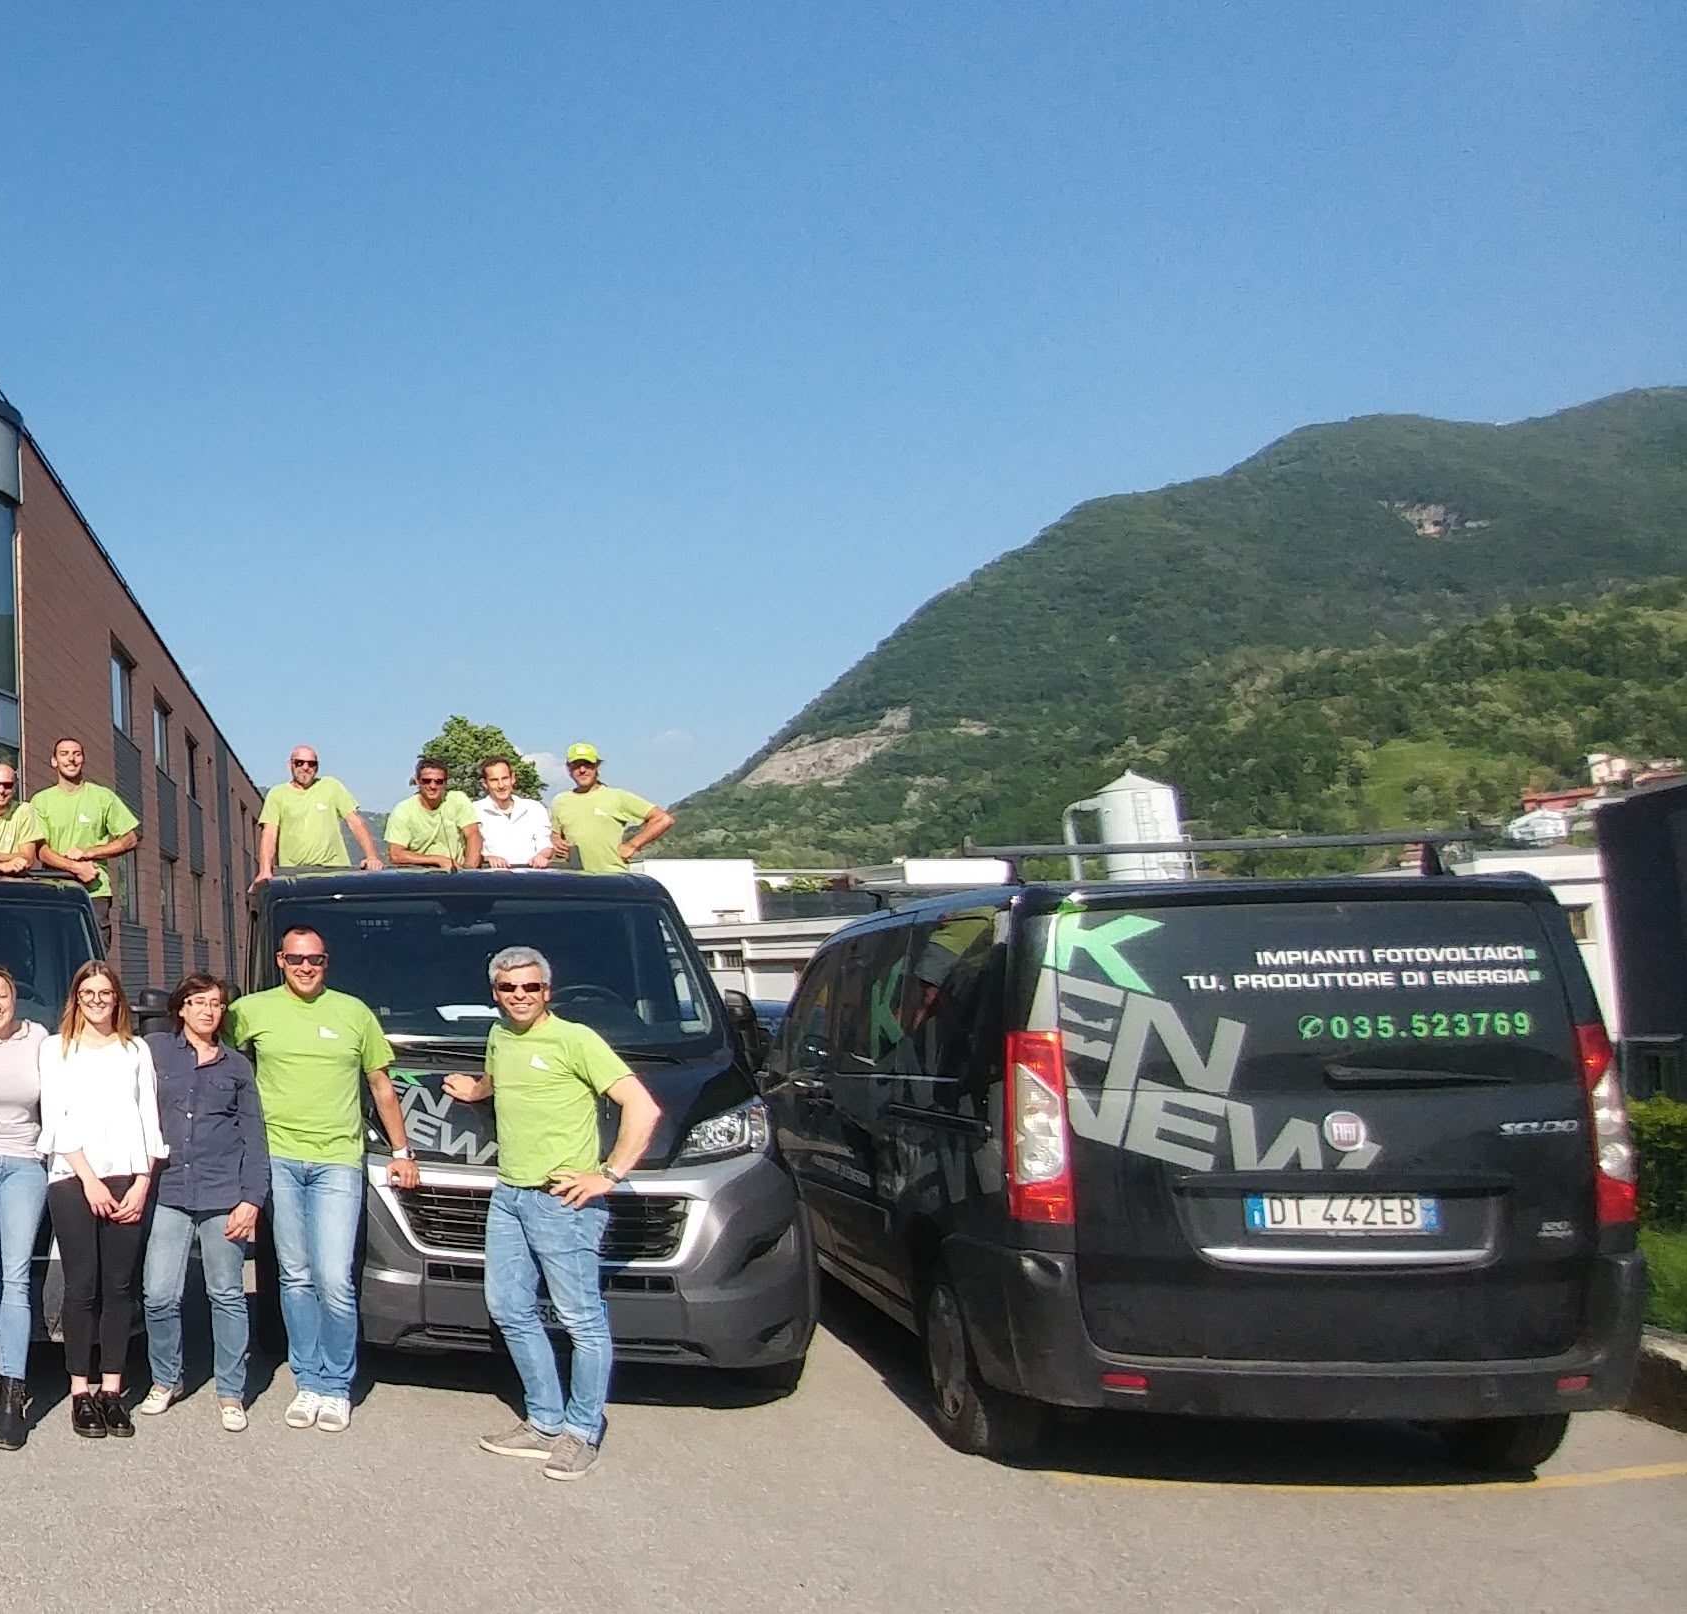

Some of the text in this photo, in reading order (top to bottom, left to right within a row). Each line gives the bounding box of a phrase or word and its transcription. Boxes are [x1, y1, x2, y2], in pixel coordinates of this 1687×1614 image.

[1042, 904, 1166, 995] K
[1256, 945, 1526, 967] IMPIANTI FOTOVOLTAICI
[1233, 971, 1395, 989] PRODUTTORE
[1402, 971, 1427, 987] DI
[1432, 968, 1530, 986] ENERGIA
[1329, 1011, 1532, 1039] 035.523769
[1269, 1198, 1303, 1225] DT
[1322, 1198, 1417, 1225] 442EB
